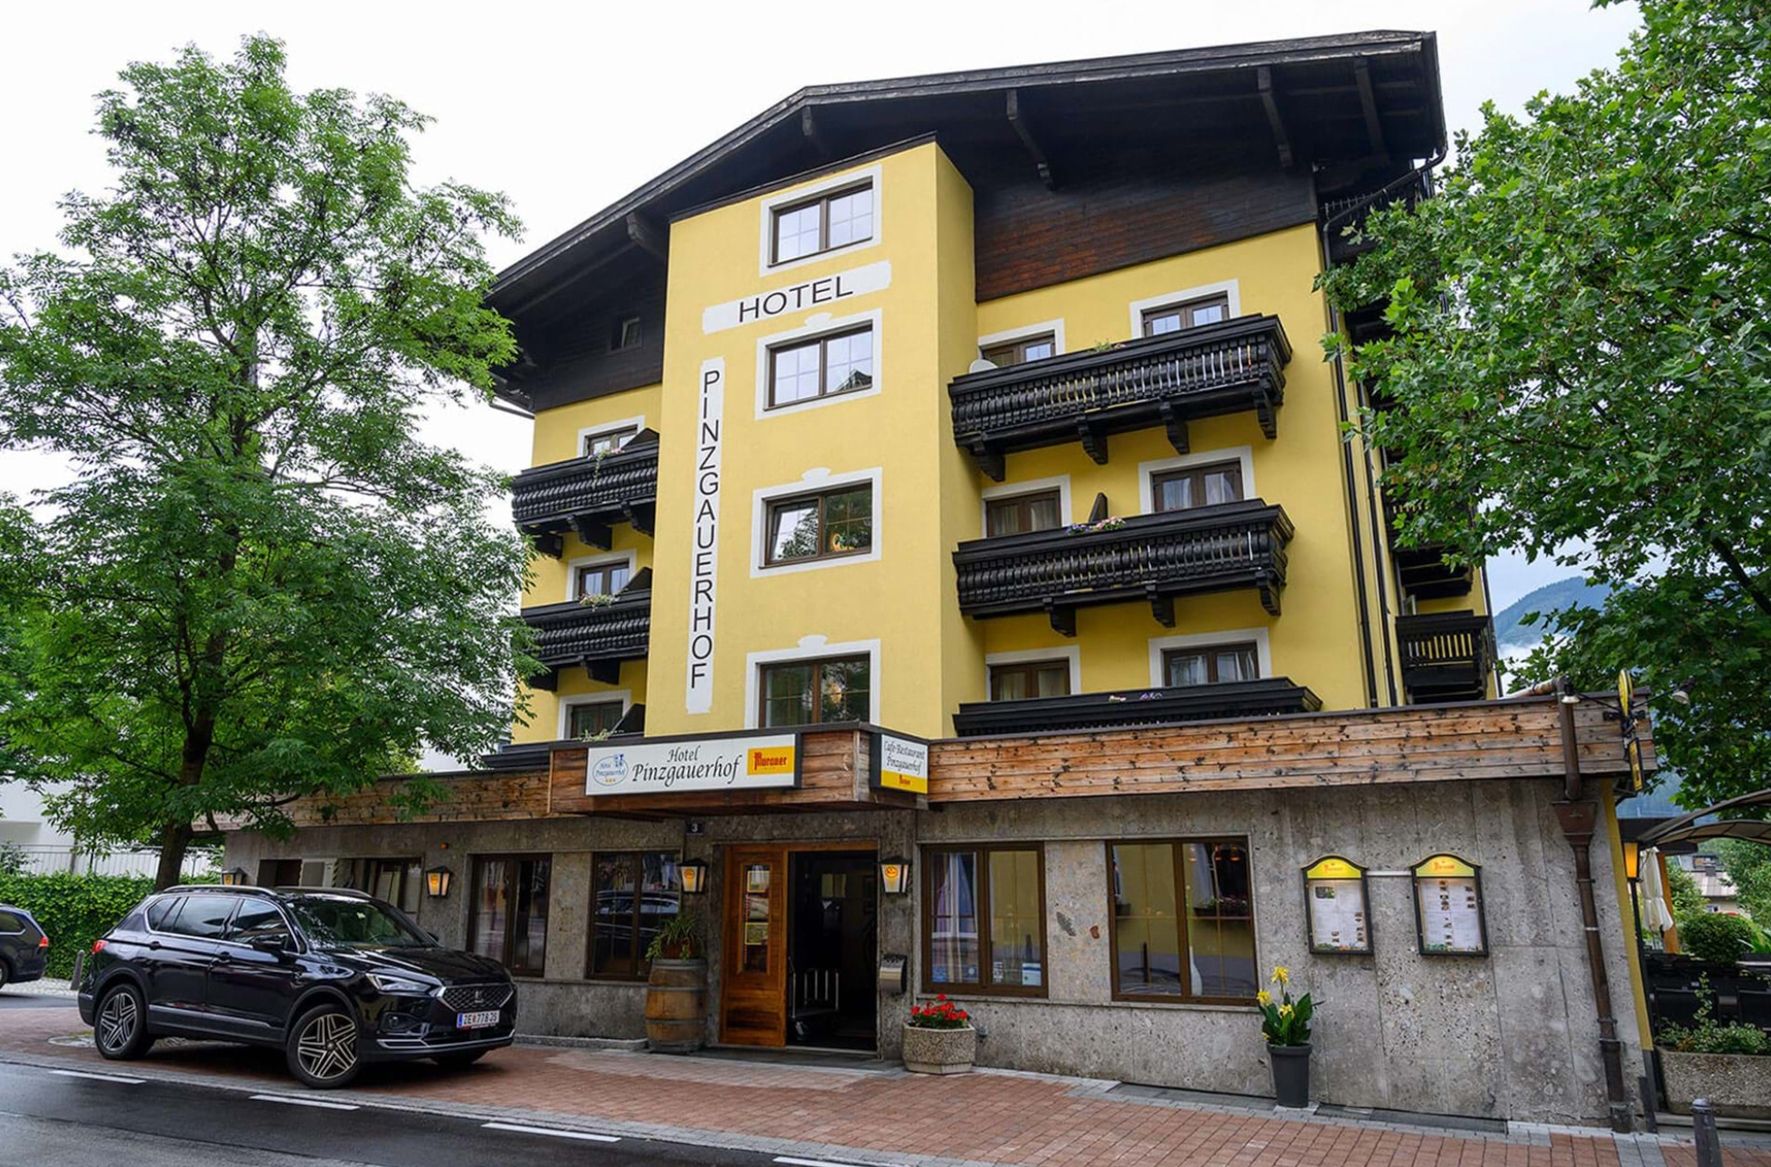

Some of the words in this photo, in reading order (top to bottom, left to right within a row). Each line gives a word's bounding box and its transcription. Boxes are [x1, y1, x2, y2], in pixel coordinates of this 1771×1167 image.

[739, 276, 853, 323] HOTEL
[691, 370, 720, 689] PINZGAUERHOF
[667, 745, 700, 763] Hotel
[632, 755, 742, 787] Pinzgauerhof
[691, 823, 698, 833] 3
